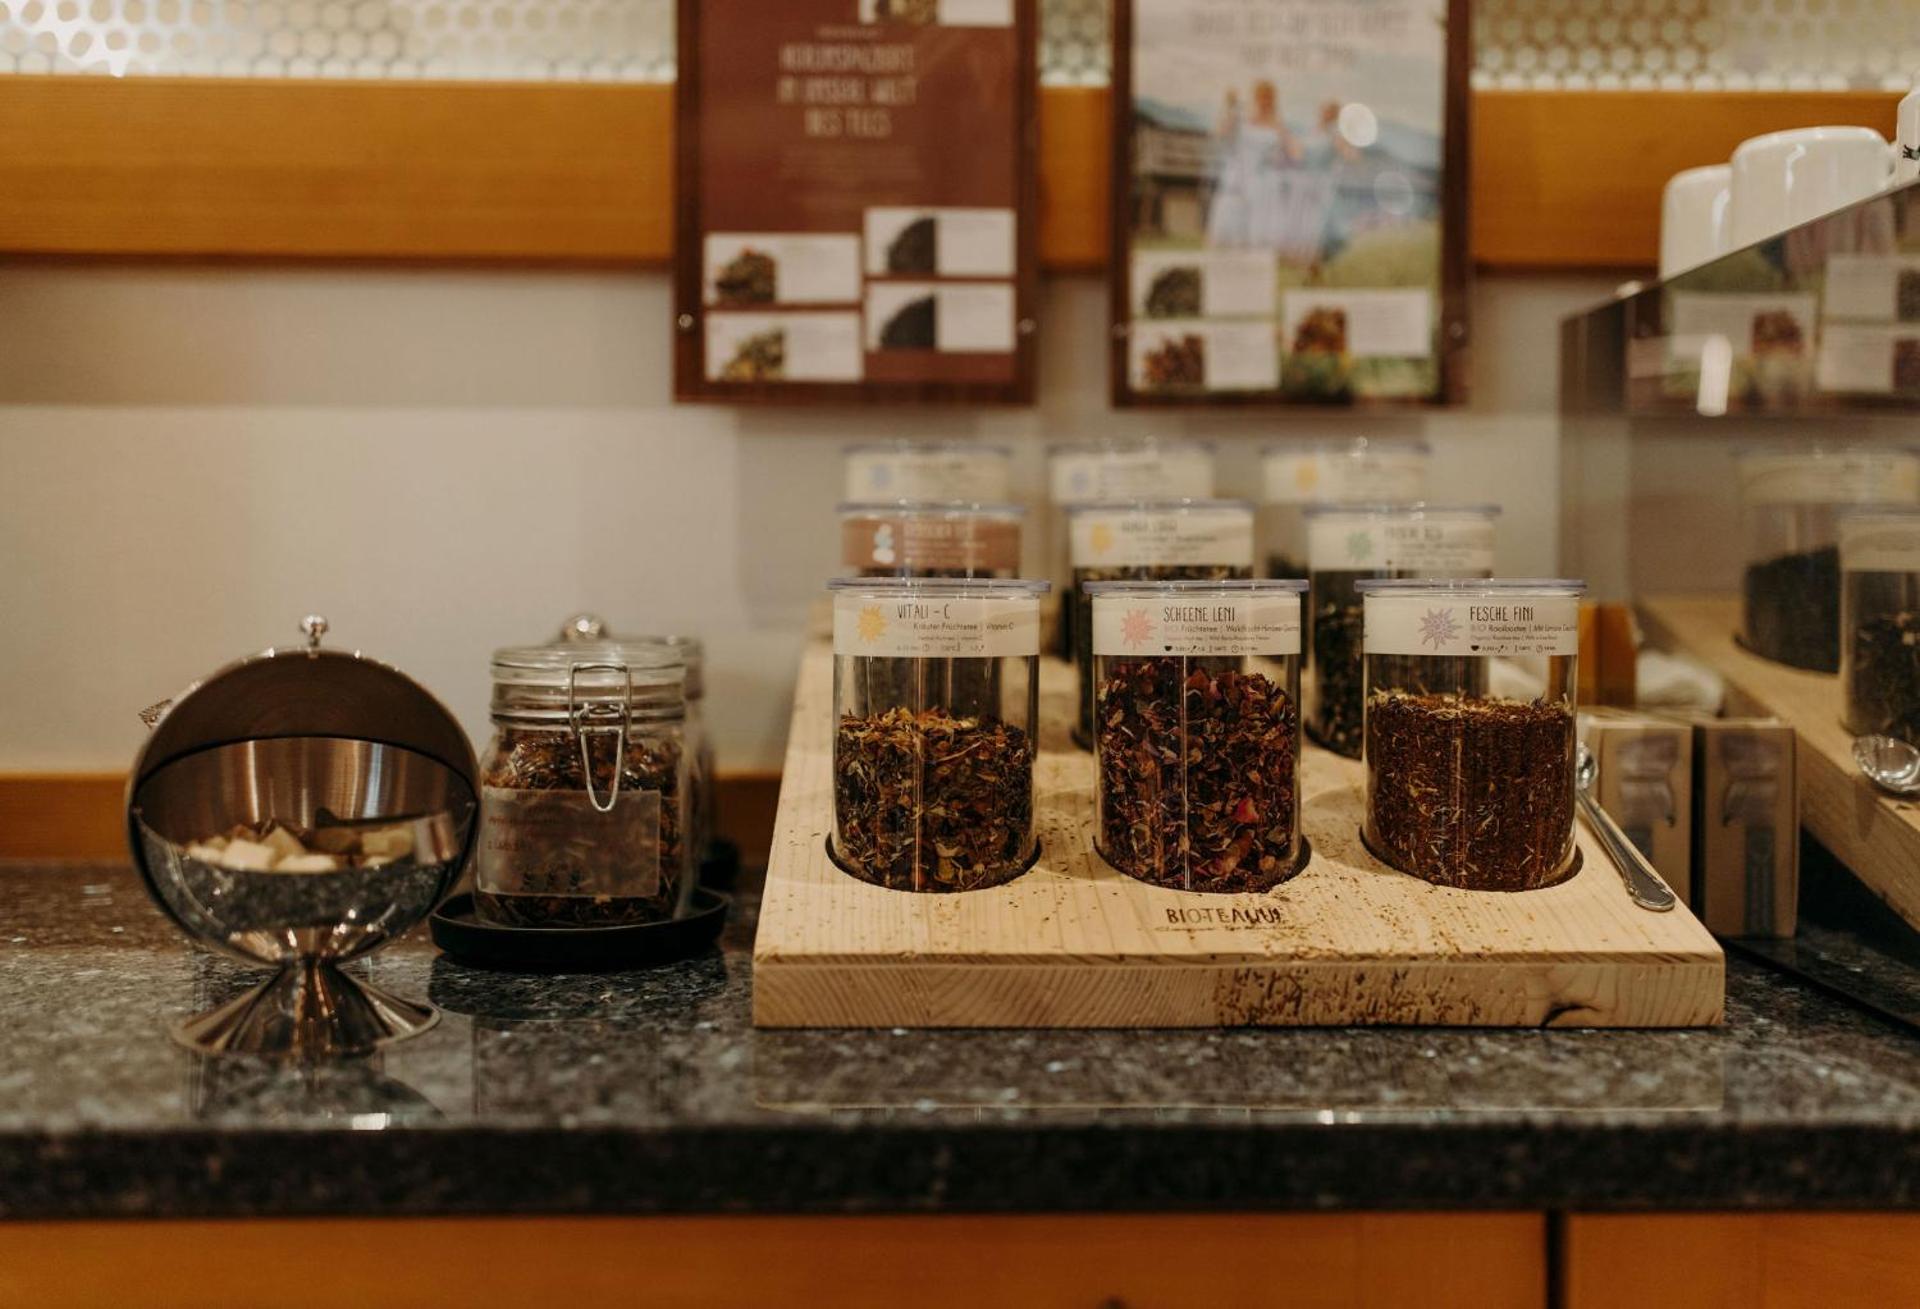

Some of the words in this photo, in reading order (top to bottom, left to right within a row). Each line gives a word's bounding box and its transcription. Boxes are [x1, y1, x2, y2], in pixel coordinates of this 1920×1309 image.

[896, 603, 929, 620] VITALI
[943, 603, 951, 620] C
[1163, 606, 1209, 623] SCHEENE
[1212, 606, 1236, 623] LENI
[1469, 606, 1509, 622] FESCHE
[1513, 606, 1534, 622] FINI
